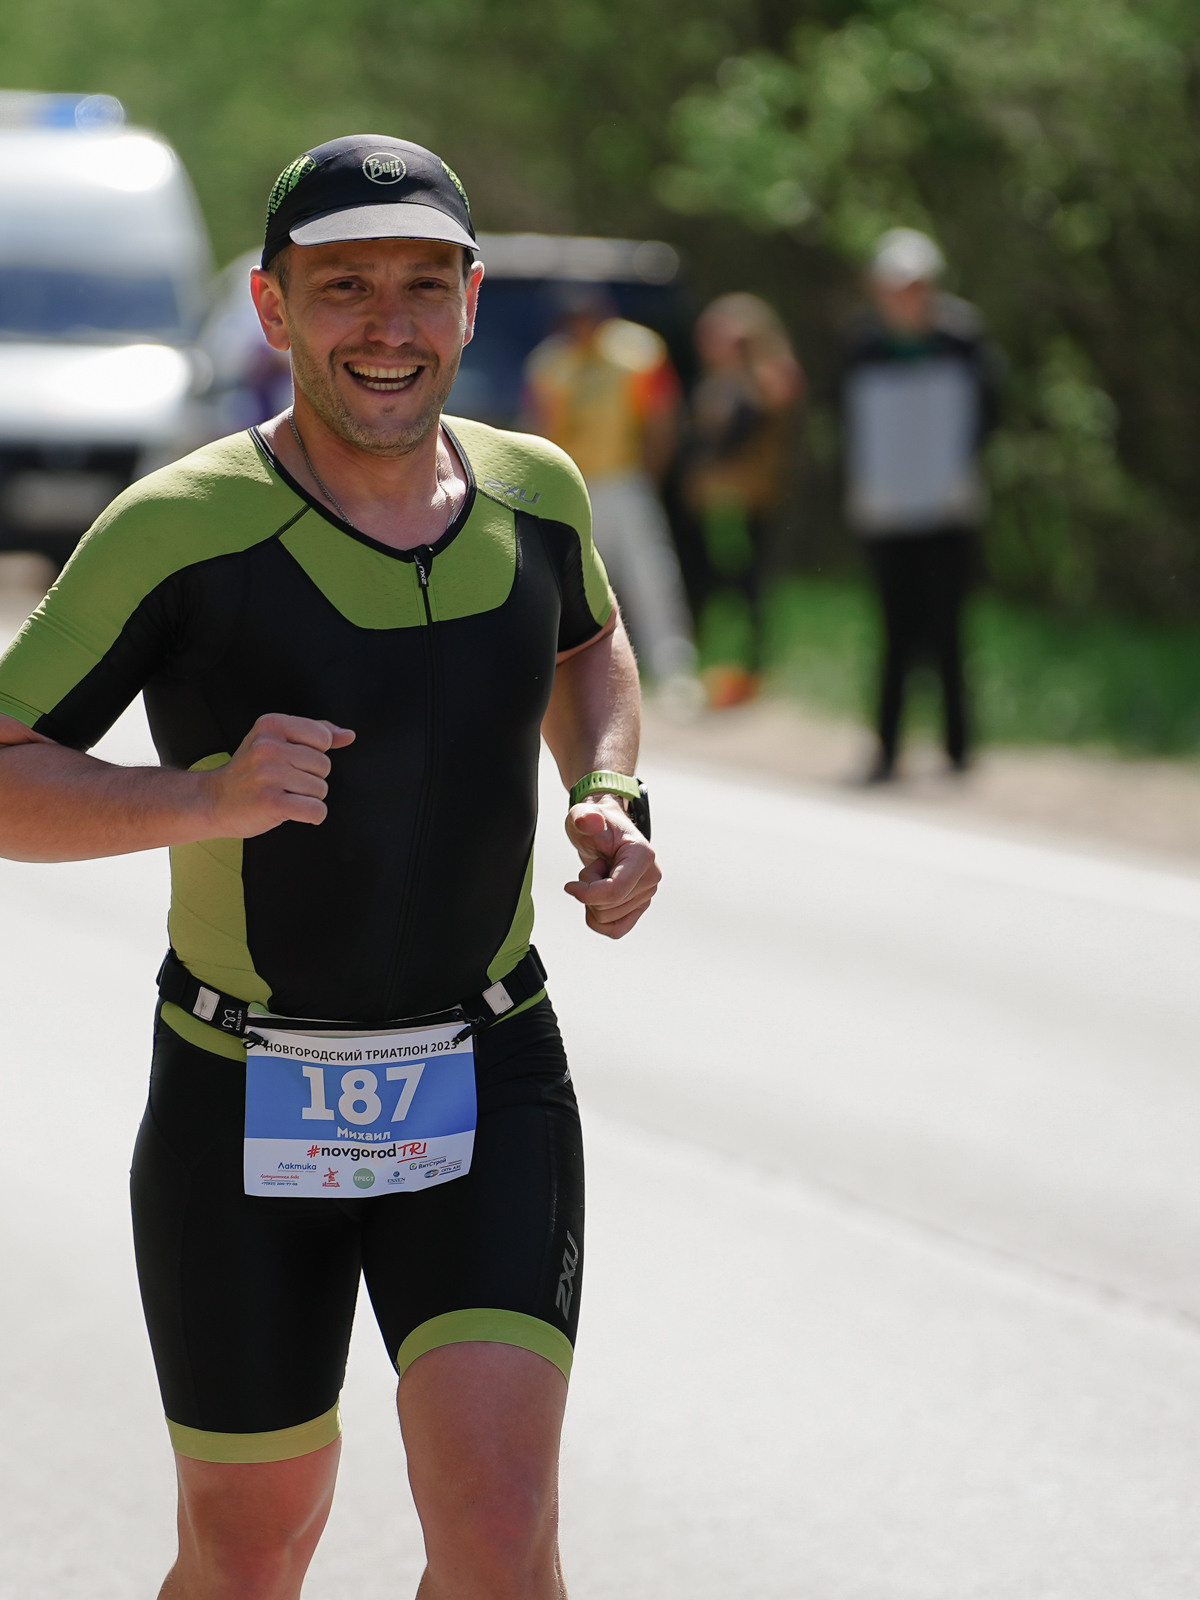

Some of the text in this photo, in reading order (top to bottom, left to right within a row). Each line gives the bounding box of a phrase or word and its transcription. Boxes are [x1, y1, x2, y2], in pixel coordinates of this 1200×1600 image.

[367, 158, 400, 178] Buff
[484, 475, 540, 504] 2XU
[265, 1040, 457, 1061] НОВГОРОДСКИЙ ТРИАТЛОН 2023
[302, 1062, 426, 1126] 187
[337, 1126, 391, 1141] Михаил
[278, 1162, 317, 1170] Лактика
[555, 1229, 579, 1321] 2XU
